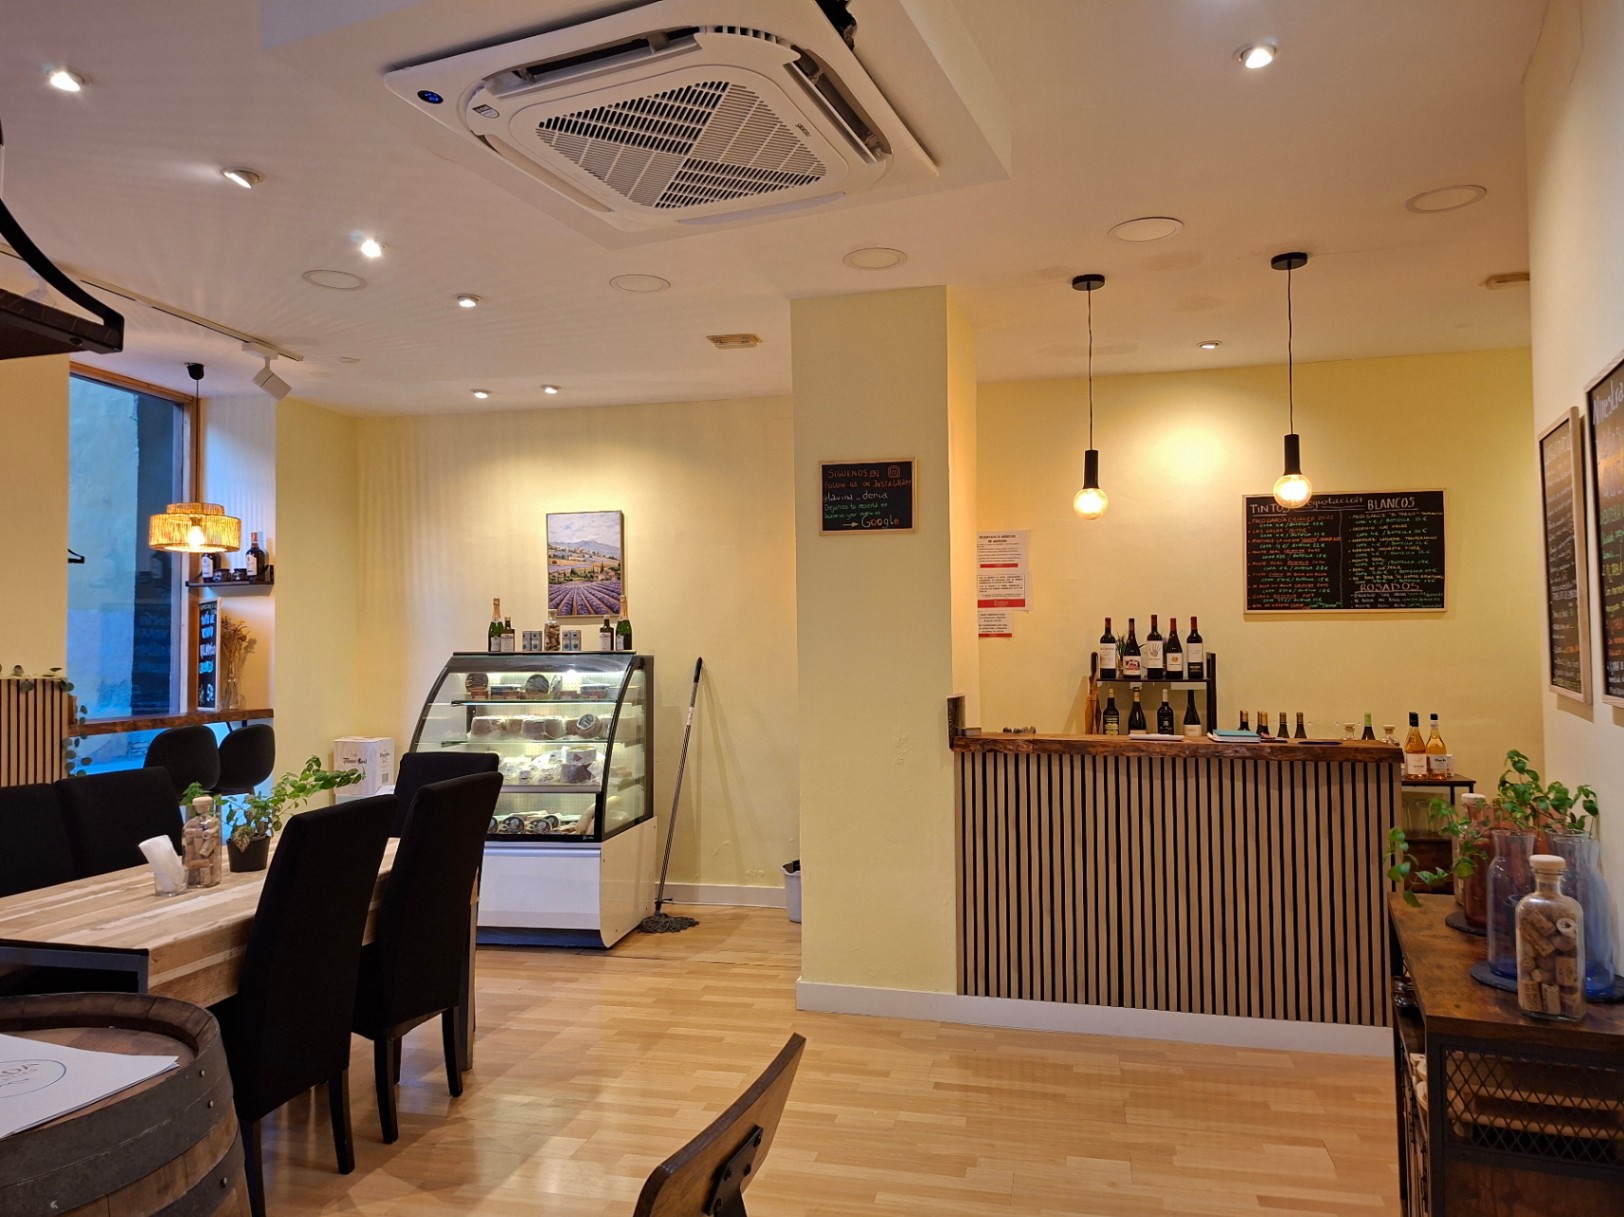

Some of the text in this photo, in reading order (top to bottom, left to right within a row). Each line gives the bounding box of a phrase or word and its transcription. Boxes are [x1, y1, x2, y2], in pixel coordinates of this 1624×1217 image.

[1367, 497, 1415, 511] BLANCOS
[861, 513, 900, 529] Google
[1359, 583, 1420, 592] ROSADOS
